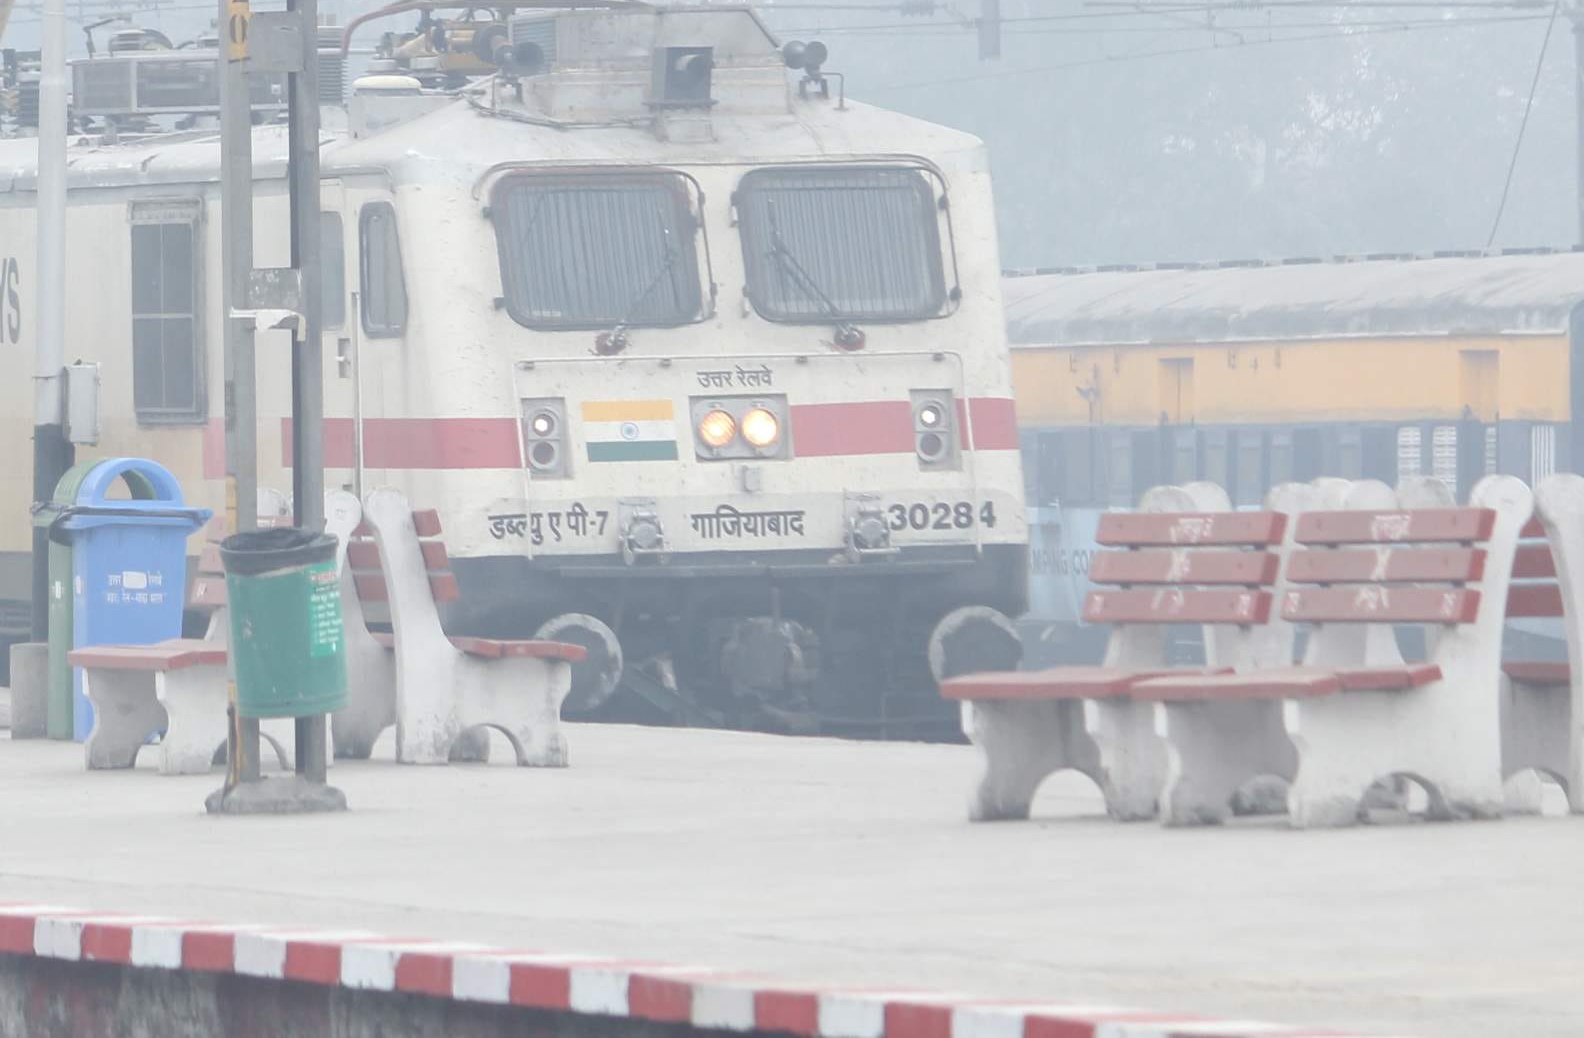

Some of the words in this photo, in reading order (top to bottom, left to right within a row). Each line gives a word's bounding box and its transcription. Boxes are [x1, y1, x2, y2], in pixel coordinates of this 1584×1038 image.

[696, 370, 734, 388] उत्तर
[735, 363, 773, 387] रेलवे
[548, 511, 562, 542] ए
[691, 504, 804, 538] गाजियाबाद
[887, 501, 996, 531] 30284
